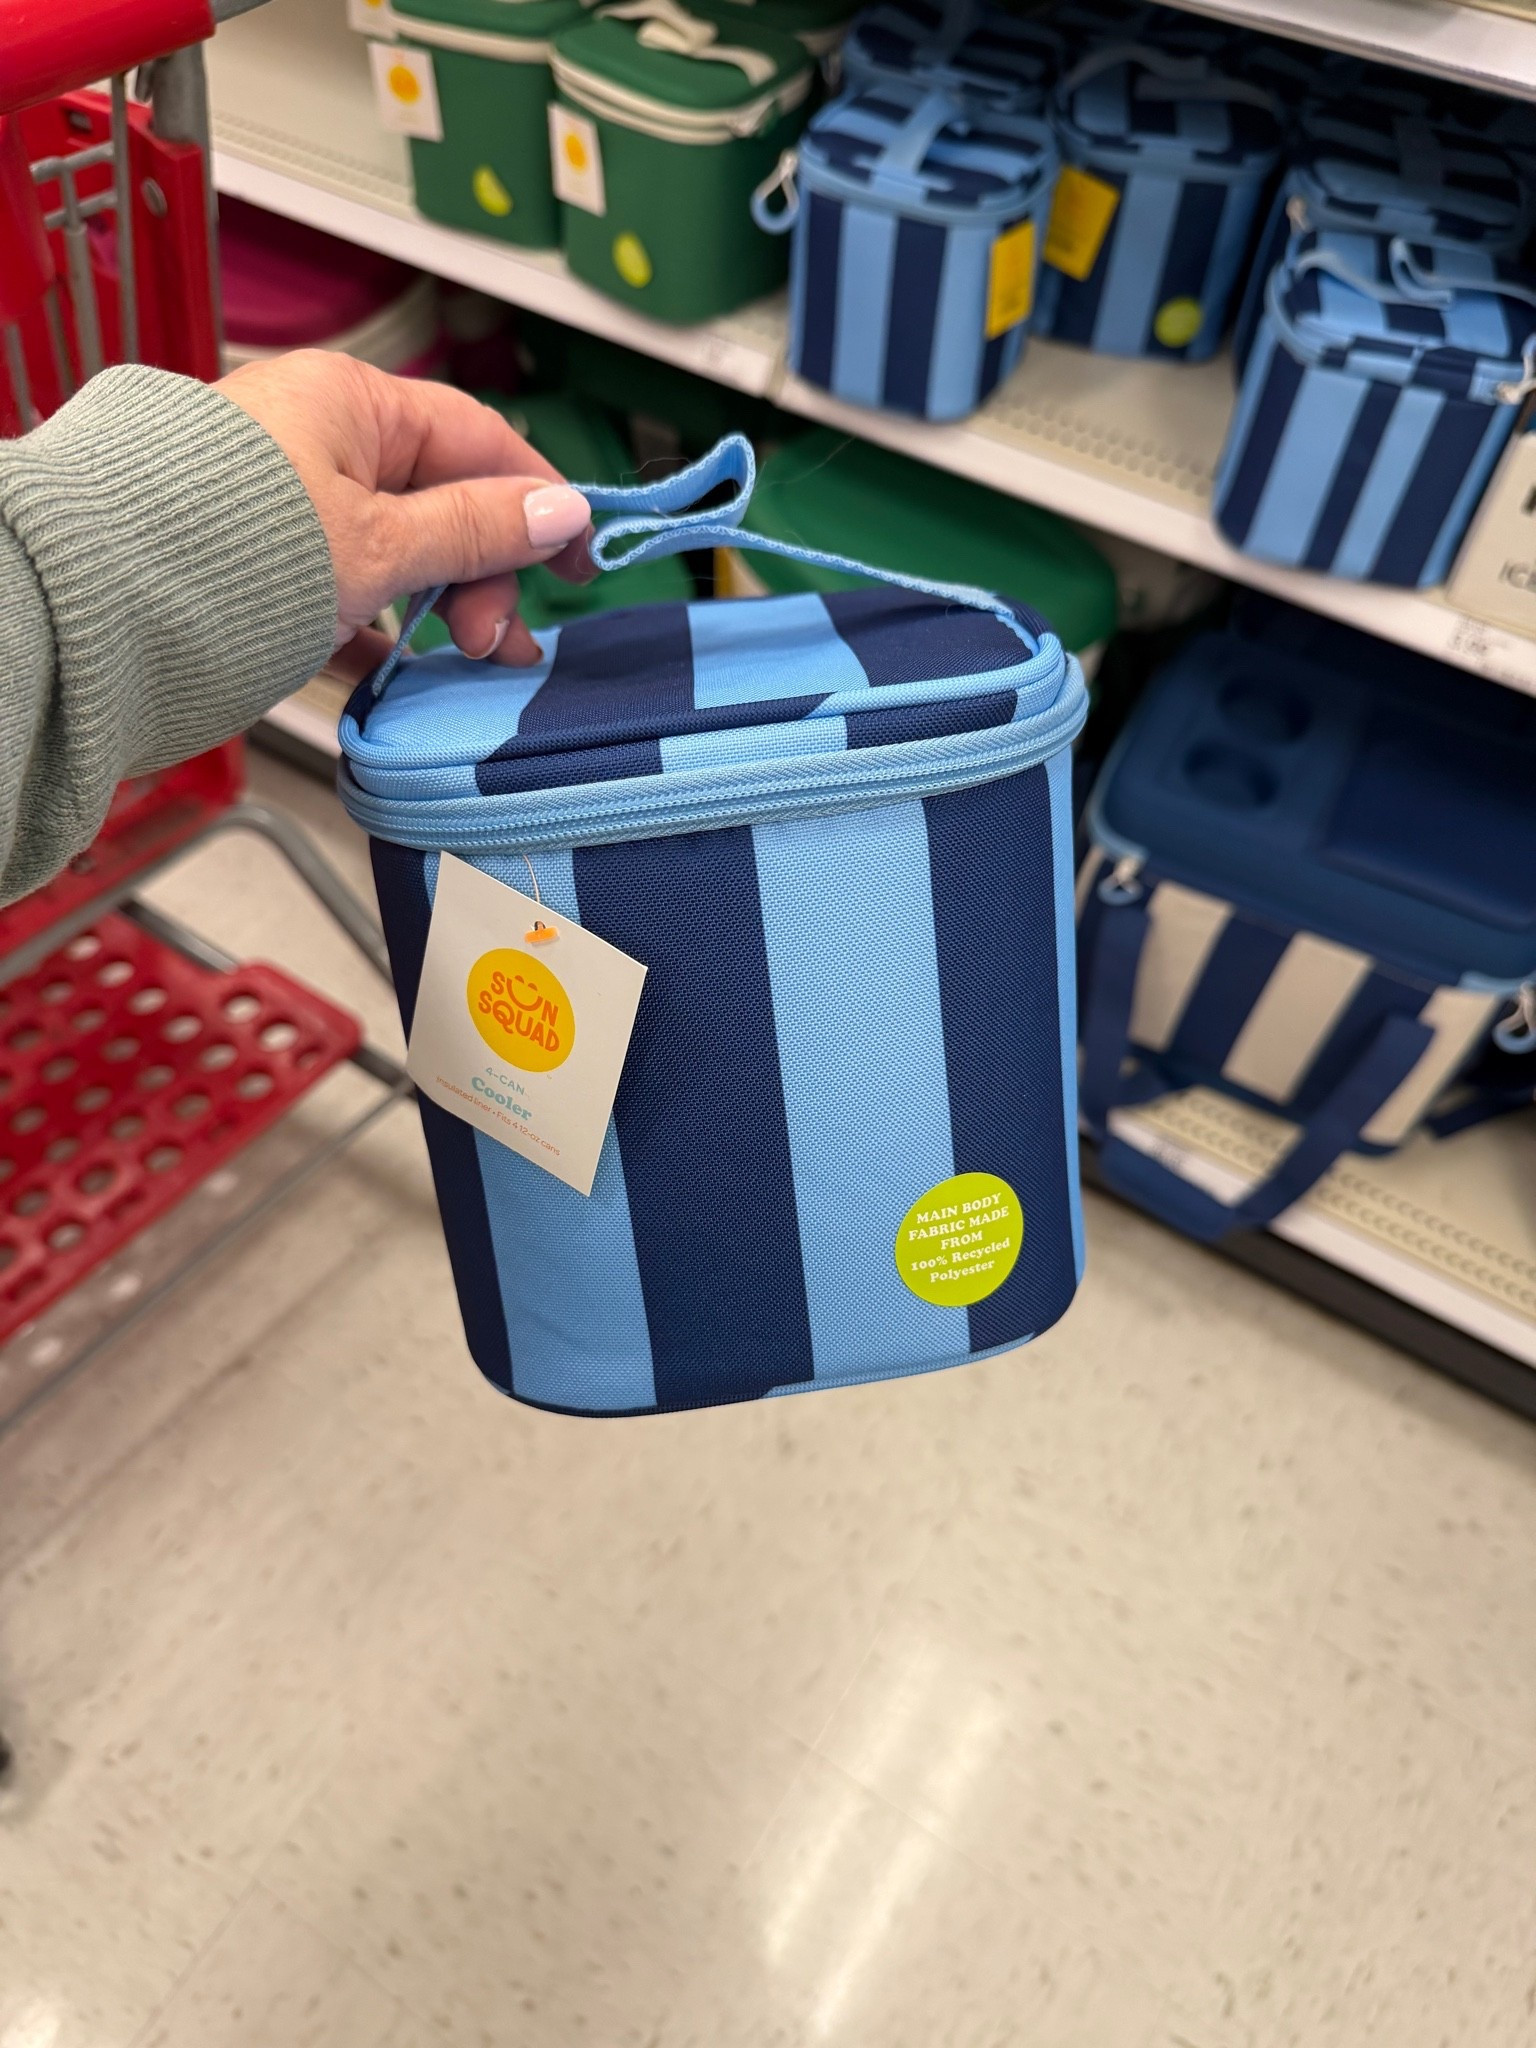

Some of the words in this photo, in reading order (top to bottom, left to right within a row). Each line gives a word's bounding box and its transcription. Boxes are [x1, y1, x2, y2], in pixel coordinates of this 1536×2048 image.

[490, 971, 559, 1027] SUN
[478, 990, 560, 1052] SQUAD
[471, 1076, 533, 1121] Cooler
[486, 1067, 525, 1096] 4-CAN
[496, 1111, 512, 1126] Fits
[519, 1124, 541, 1143] 12-oz
[540, 1140, 561, 1156] cans
[908, 1219, 966, 1241] FABRIC
[969, 1206, 1009, 1228] MADE
[917, 1205, 958, 1224] MAIN
[962, 1193, 1001, 1214] BODY
[911, 1255, 948, 1271] 100%
[952, 1237, 1010, 1263] Recycled
[940, 1231, 983, 1250] FROM
[930, 1260, 995, 1283] Polyester
